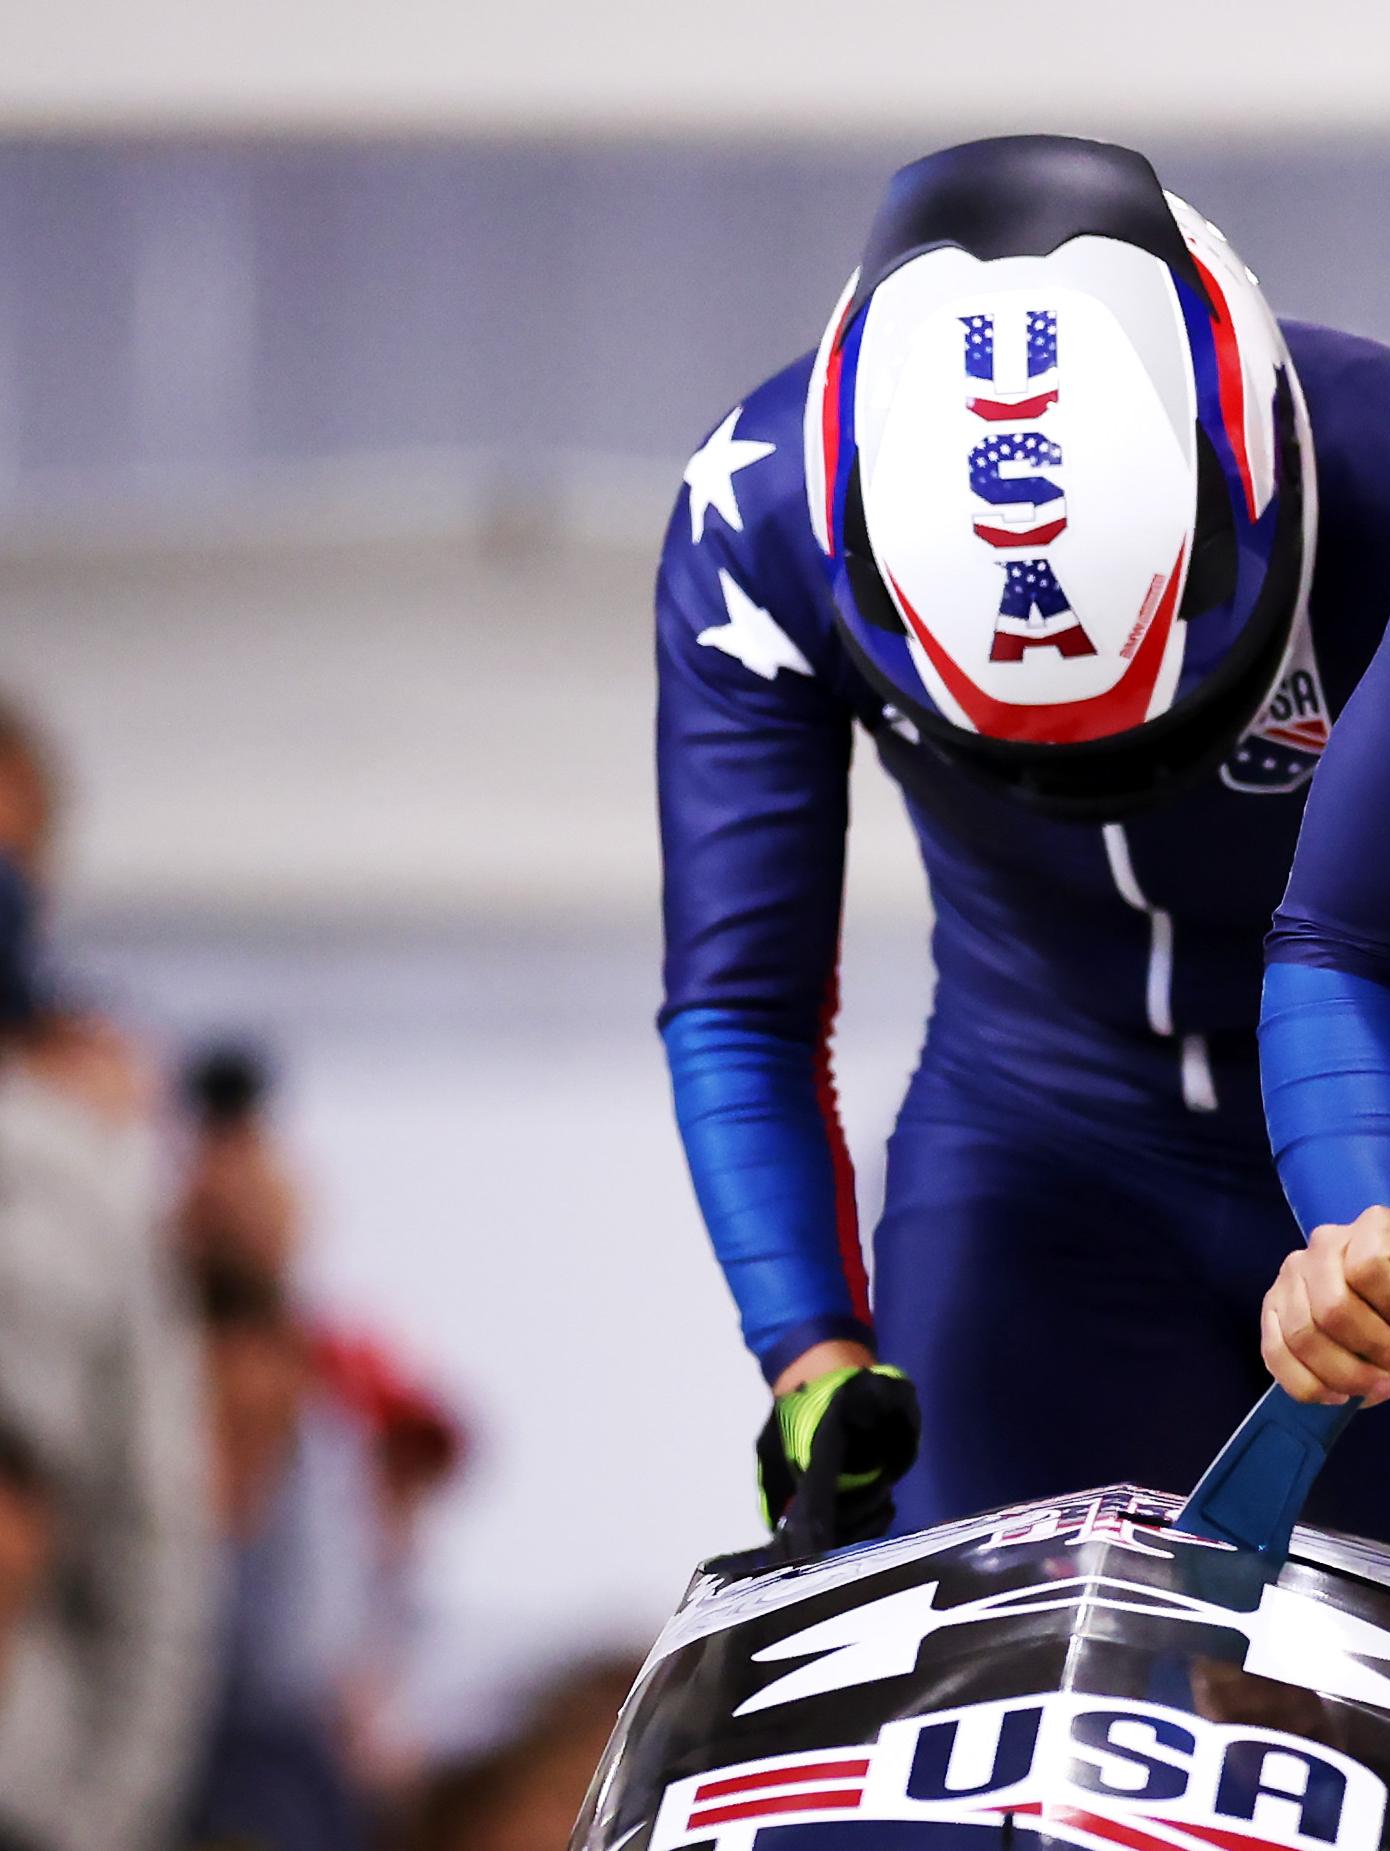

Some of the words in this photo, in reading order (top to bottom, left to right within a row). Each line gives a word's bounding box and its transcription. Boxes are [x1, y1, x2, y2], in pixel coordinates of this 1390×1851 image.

[957, 310, 1098, 663] USA
[1258, 669, 1320, 723] SA
[904, 1705, 1349, 1846] USA
